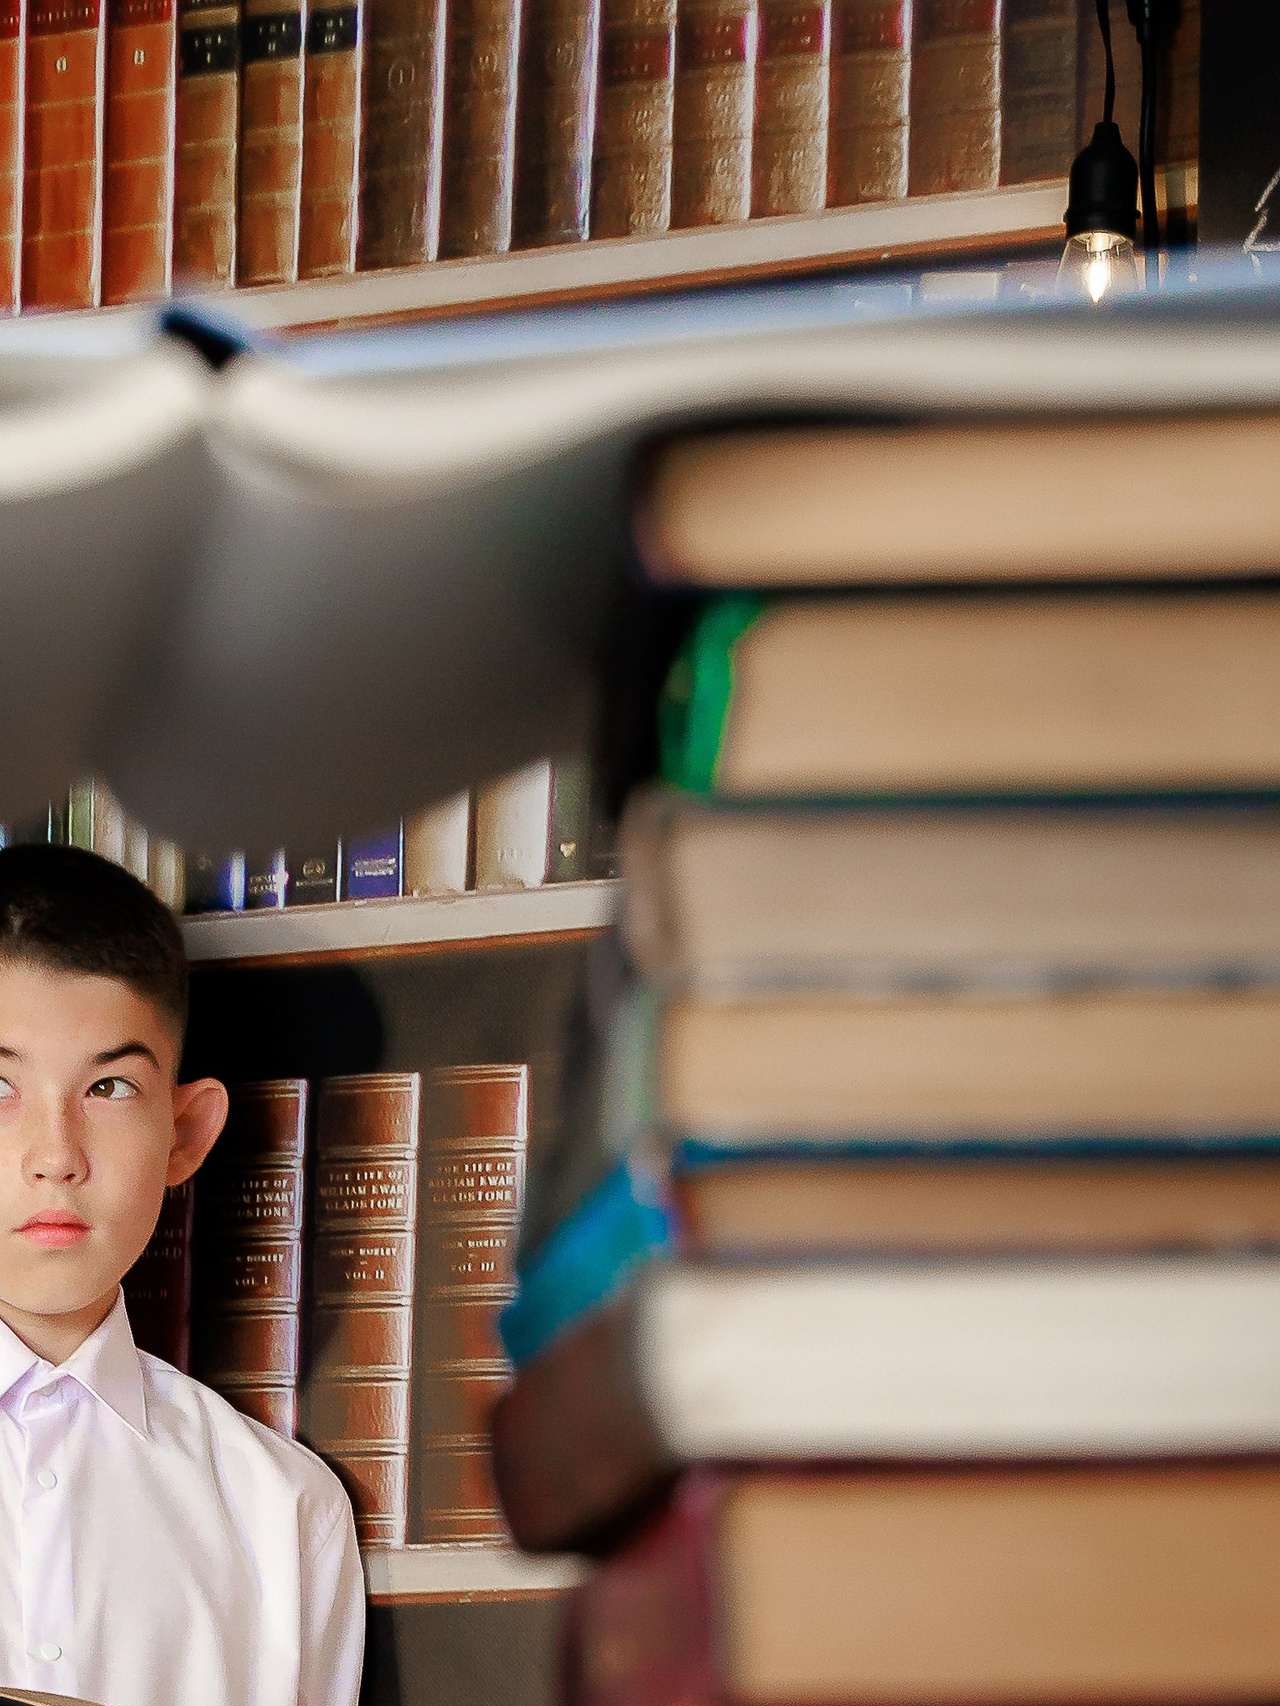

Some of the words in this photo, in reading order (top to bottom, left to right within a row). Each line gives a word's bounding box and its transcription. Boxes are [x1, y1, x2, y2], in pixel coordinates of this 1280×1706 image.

[464, 1163, 493, 1173] LIFE
[496, 1162, 512, 1172] OF
[356, 1170, 383, 1181] LIFE
[387, 1169, 404, 1180] OF
[479, 1174, 517, 1187] EWAR
[241, 1179, 269, 1189] LIFE
[273, 1178, 289, 1189] OF
[255, 1190, 295, 1203] EWART
[319, 1185, 367, 1197] WILLIAM
[432, 1189, 513, 1203] GLADSTONE
[324, 1197, 403, 1210] GLADSTONE
[214, 1206, 289, 1220] ADSTONE
[467, 1238, 508, 1248] MORLEY
[359, 1246, 397, 1256] MORLEY
[246, 1253, 285, 1263] MORLEY
[480, 1261, 495, 1272] III
[264, 1275, 269, 1285] I
[375, 1268, 385, 1280] II
